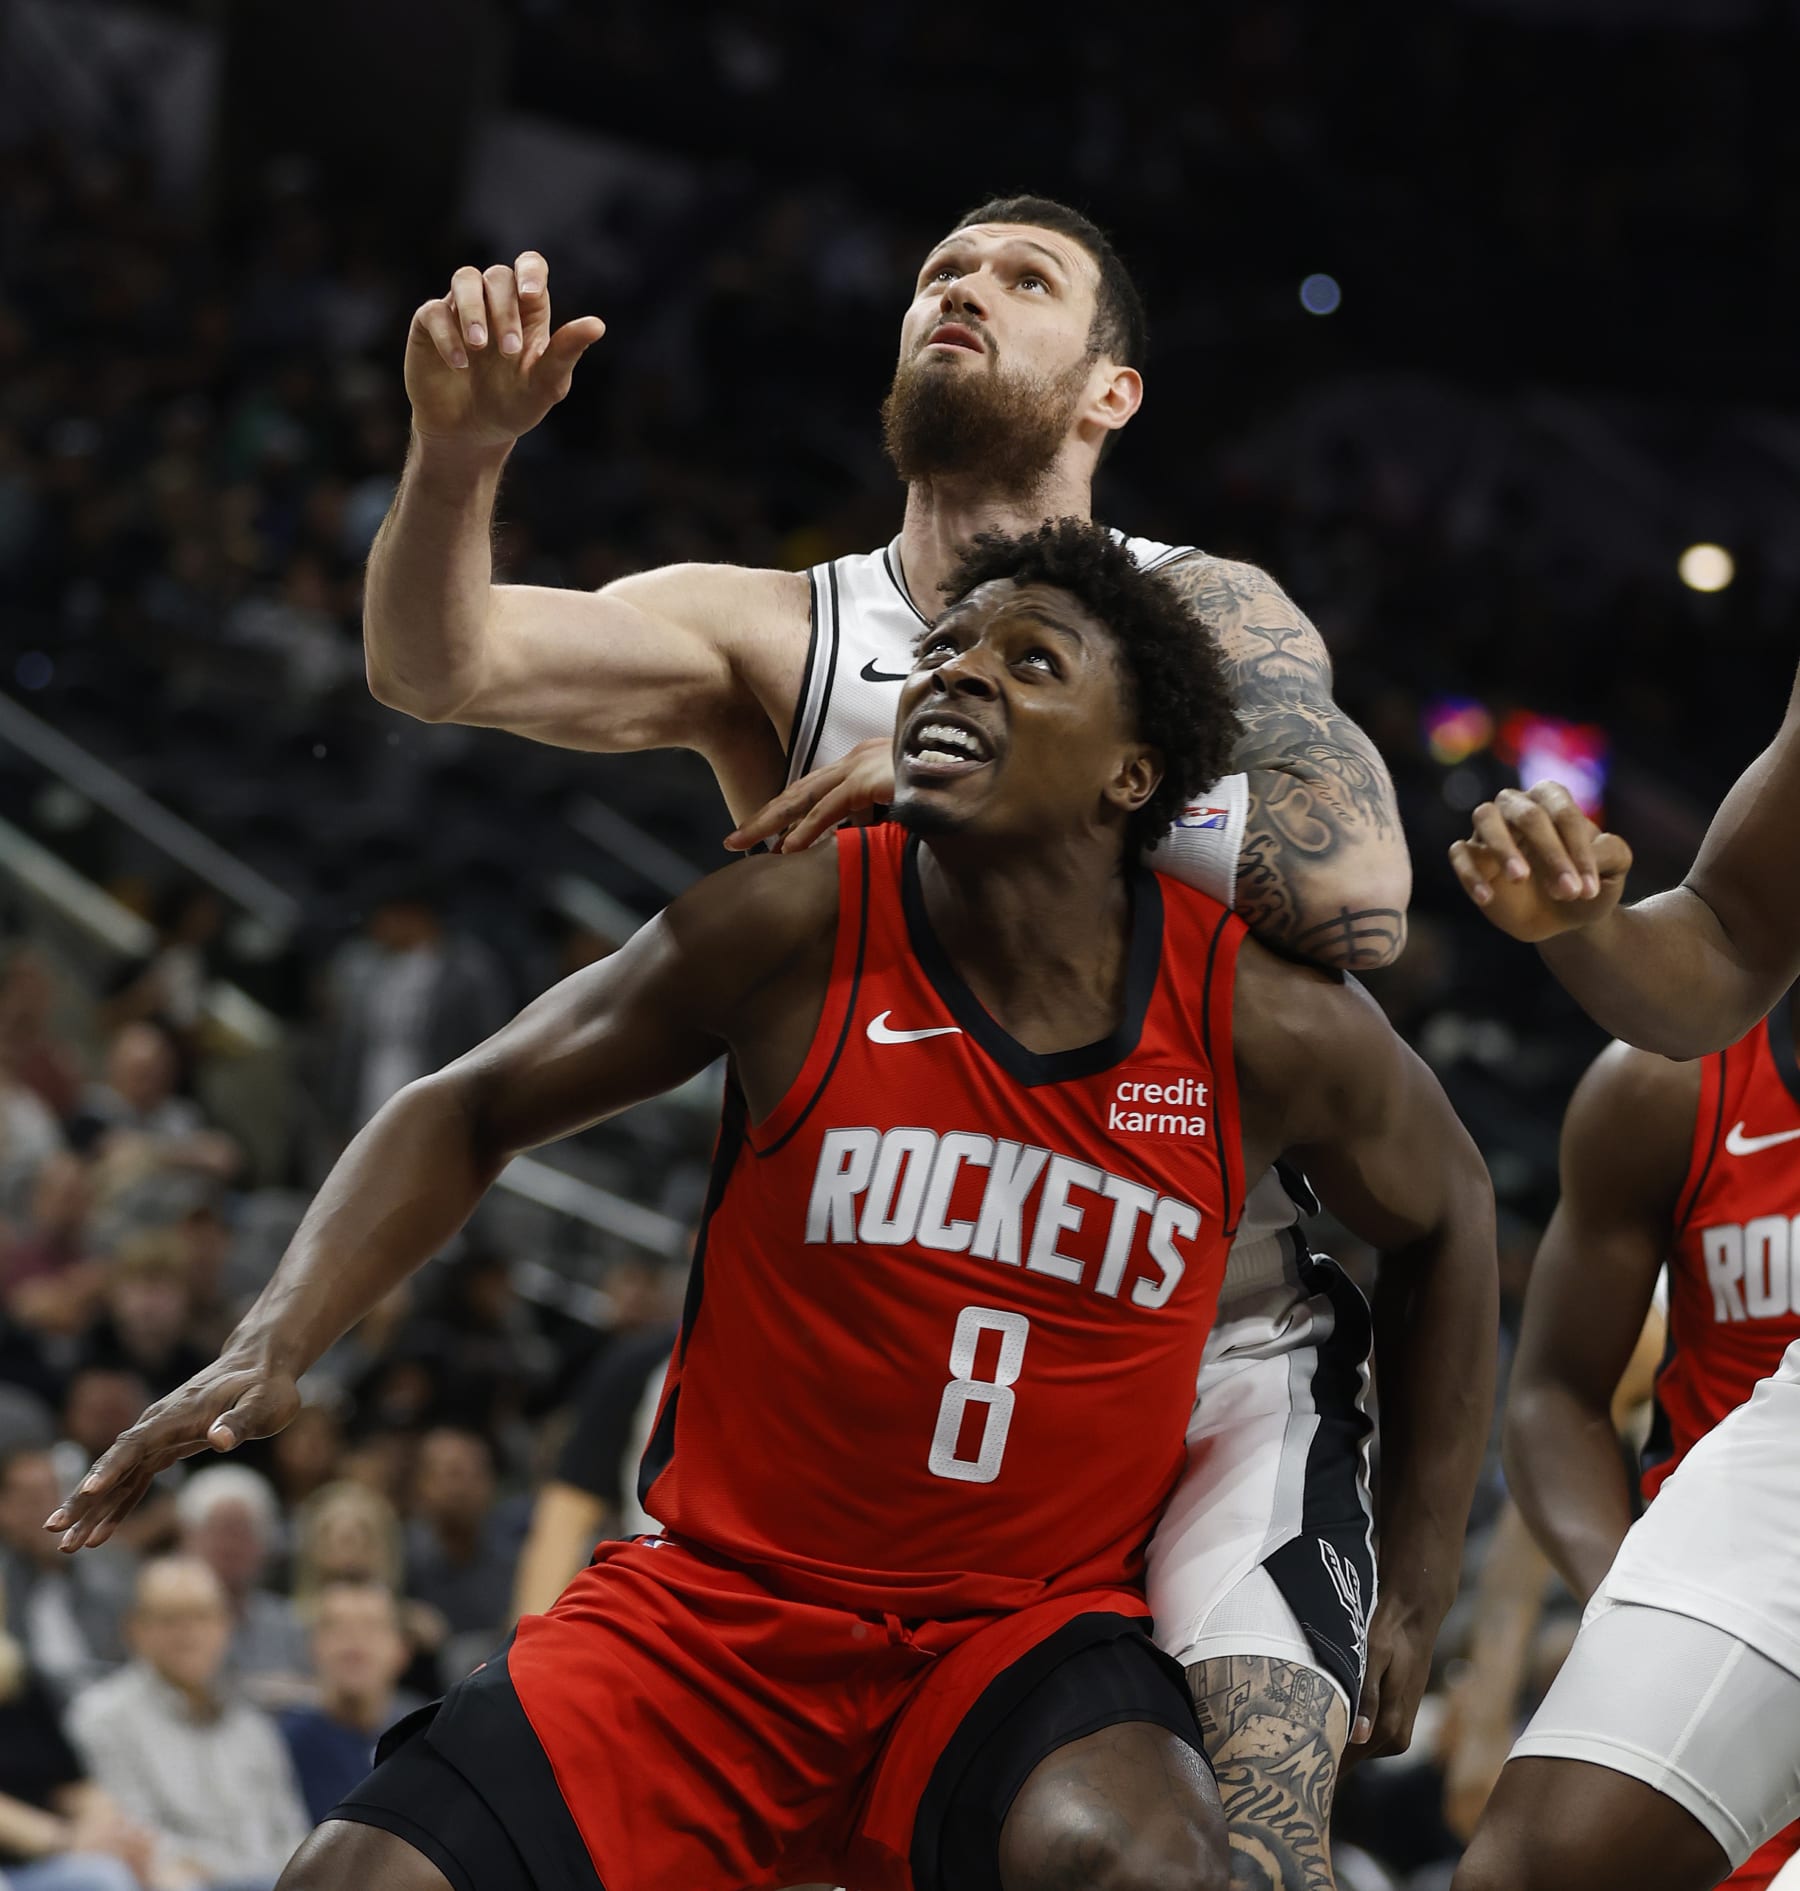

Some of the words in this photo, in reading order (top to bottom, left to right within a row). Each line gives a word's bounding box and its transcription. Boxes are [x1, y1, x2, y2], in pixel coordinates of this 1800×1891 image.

[1108, 1103, 1206, 1137] karma
[1116, 1078, 1208, 1107] credit
[804, 1126, 1201, 1310] ROCKETS
[1702, 1213, 1800, 1324] RO
[928, 1306, 1030, 1483] 8
